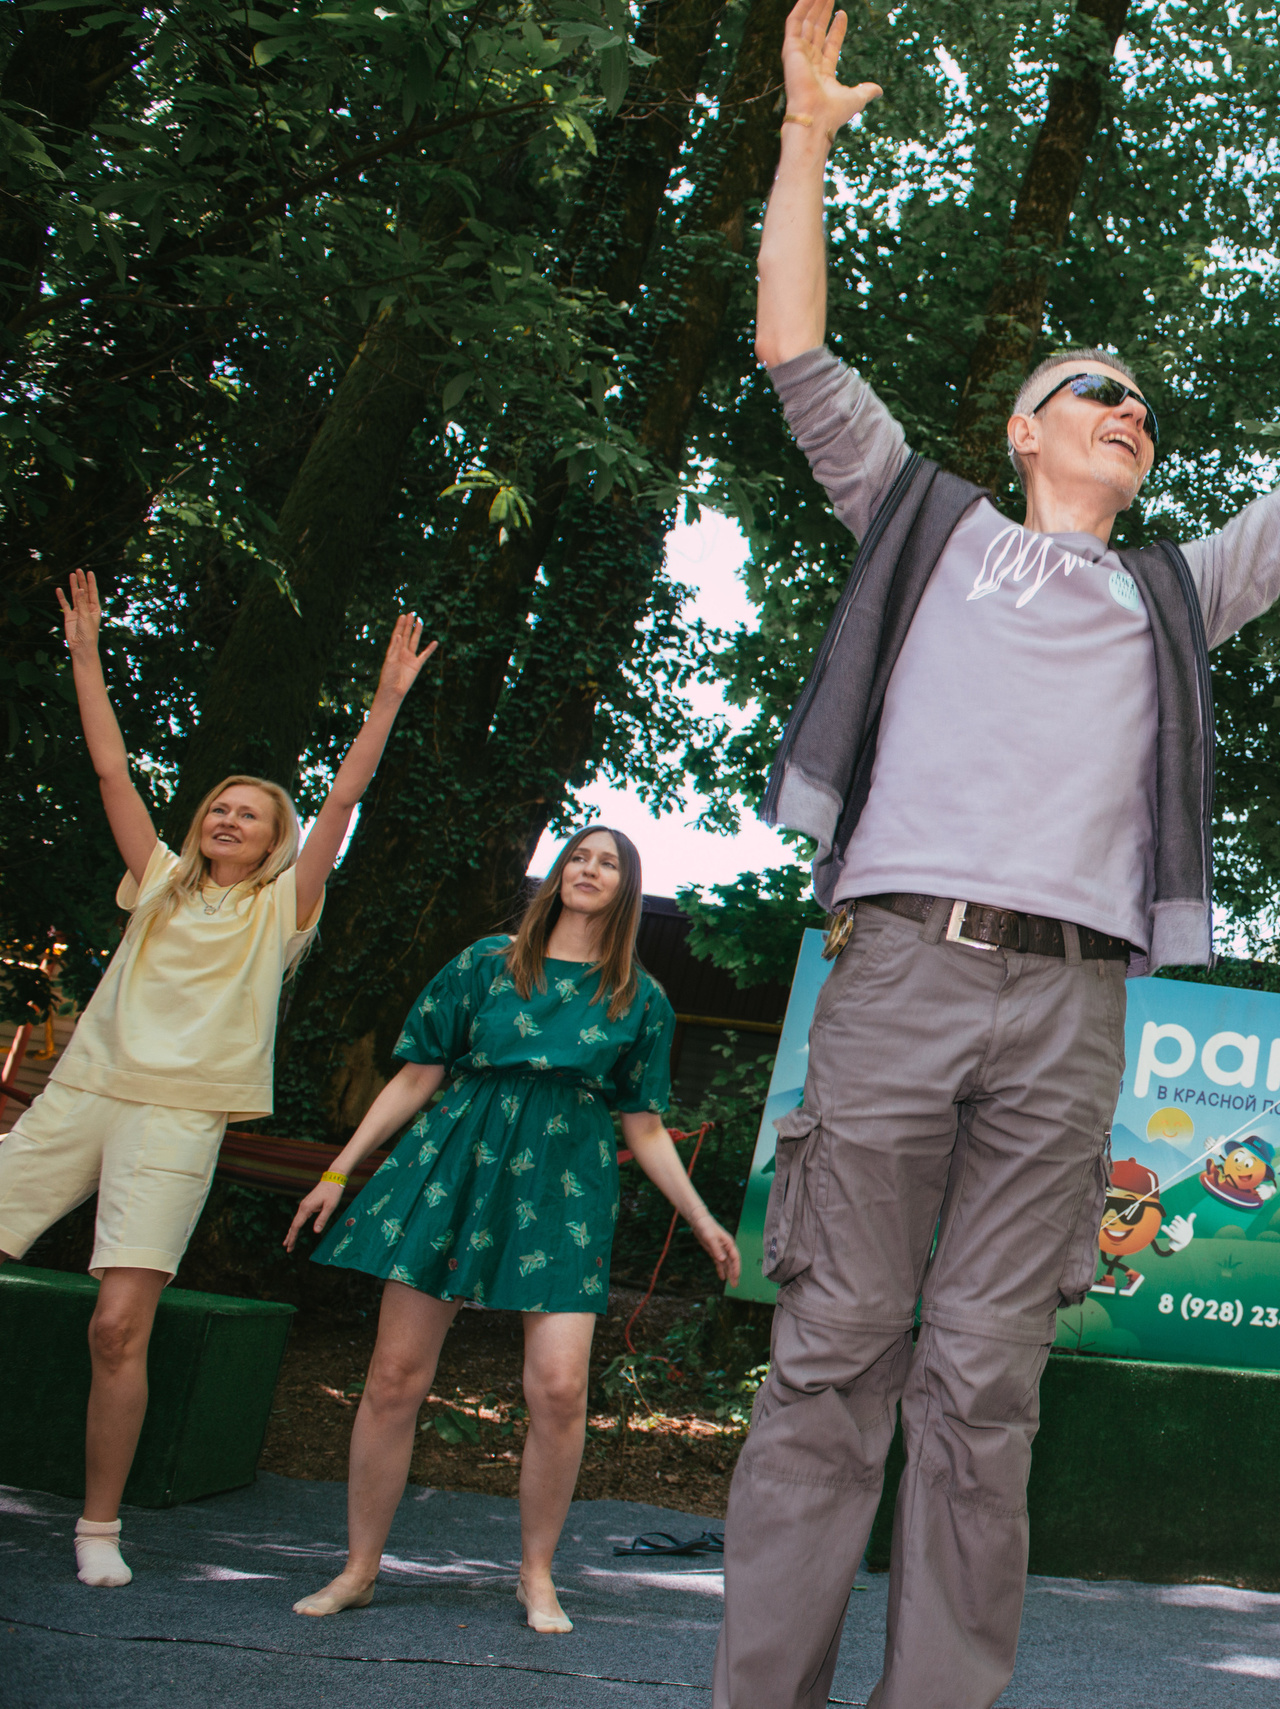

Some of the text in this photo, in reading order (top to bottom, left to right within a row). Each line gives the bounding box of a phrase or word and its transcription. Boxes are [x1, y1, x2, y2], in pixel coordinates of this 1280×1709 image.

[1157, 1085, 1168, 1100] В
[1173, 1087, 1257, 1112] КРАСНОЙ
[1158, 1293, 1174, 1314] 8
[1180, 1292, 1244, 1327] (928)
